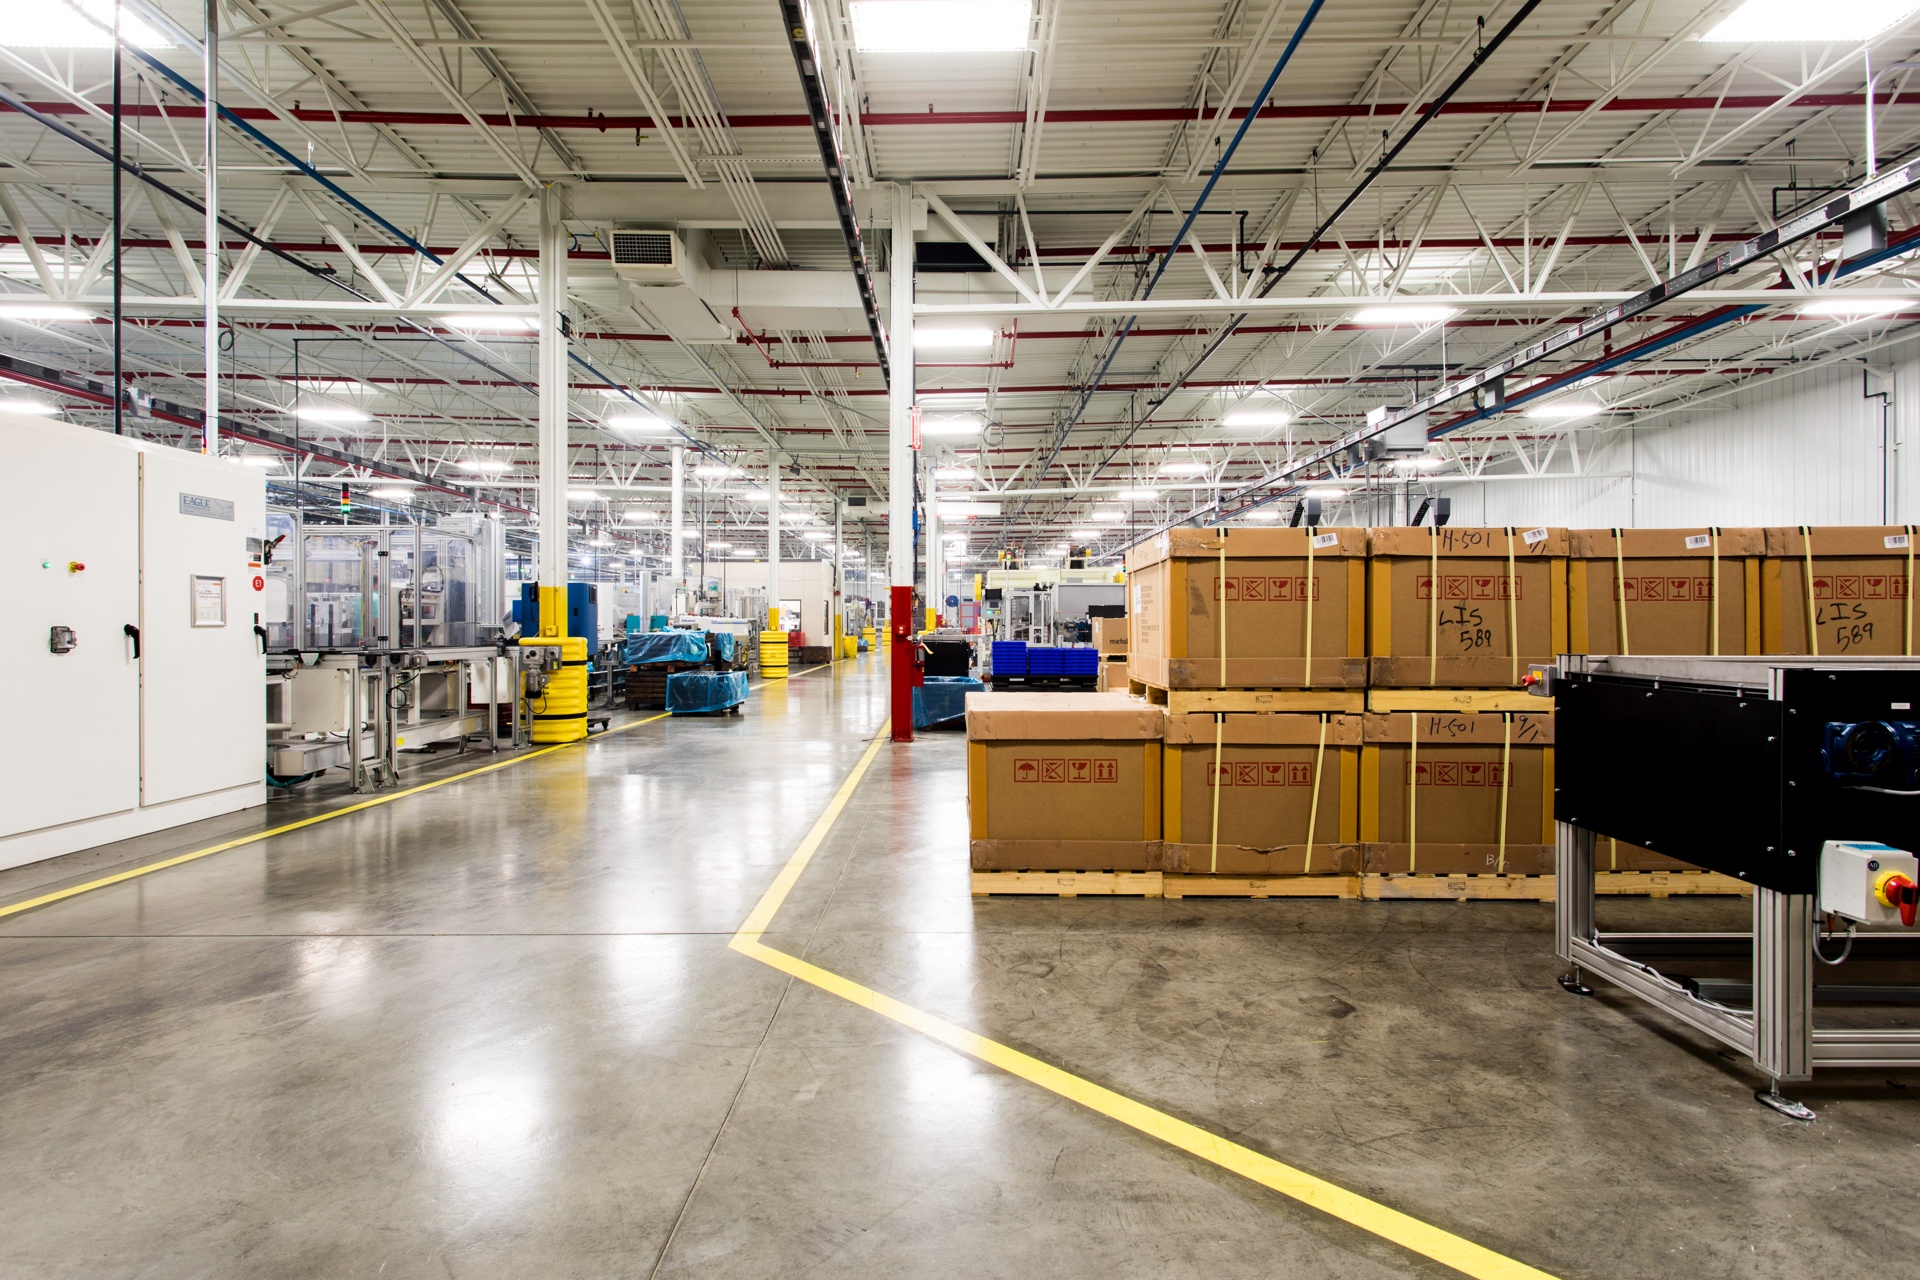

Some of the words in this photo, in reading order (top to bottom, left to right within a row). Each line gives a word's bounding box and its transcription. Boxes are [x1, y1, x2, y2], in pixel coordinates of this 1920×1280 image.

[183, 495, 211, 508] EAGLE
[1443, 529, 1489, 552] H-501
[255, 579, 262, 588] E1
[1439, 605, 1483, 627] LIS
[1816, 603, 1868, 625] LIS
[1460, 629, 1492, 652] 589
[1837, 622, 1873, 652] 589
[1430, 716, 1475, 737] H-501
